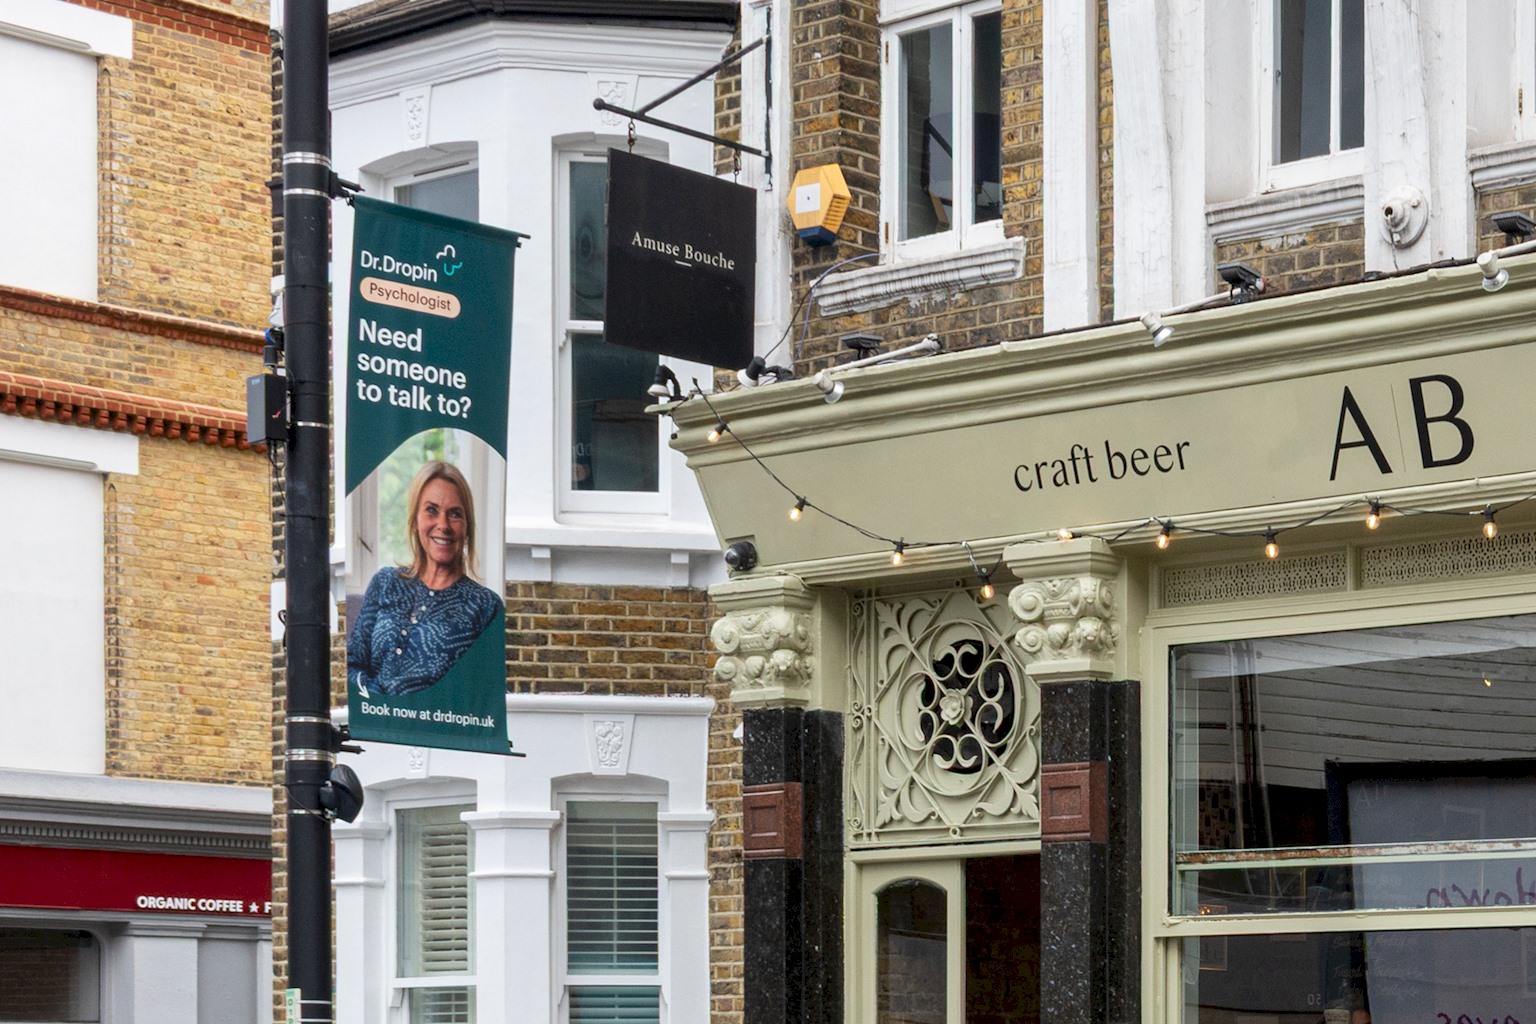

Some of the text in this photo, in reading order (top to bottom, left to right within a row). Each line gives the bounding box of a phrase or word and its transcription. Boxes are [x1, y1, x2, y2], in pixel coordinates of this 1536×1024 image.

[360, 250, 438, 282] Dr.Dropin
[631, 231, 736, 270] Amuse Bouche
[369, 282, 452, 311] Psychologist
[358, 318, 423, 352] Need
[357, 352, 467, 390] someone
[356, 378, 472, 419] to talk to?
[1013, 439, 1191, 492] craft beer
[361, 701, 495, 728] Book now at drdropin.uk
[136, 895, 196, 911] ORGANIC
[197, 898, 243, 913] COFFEE
